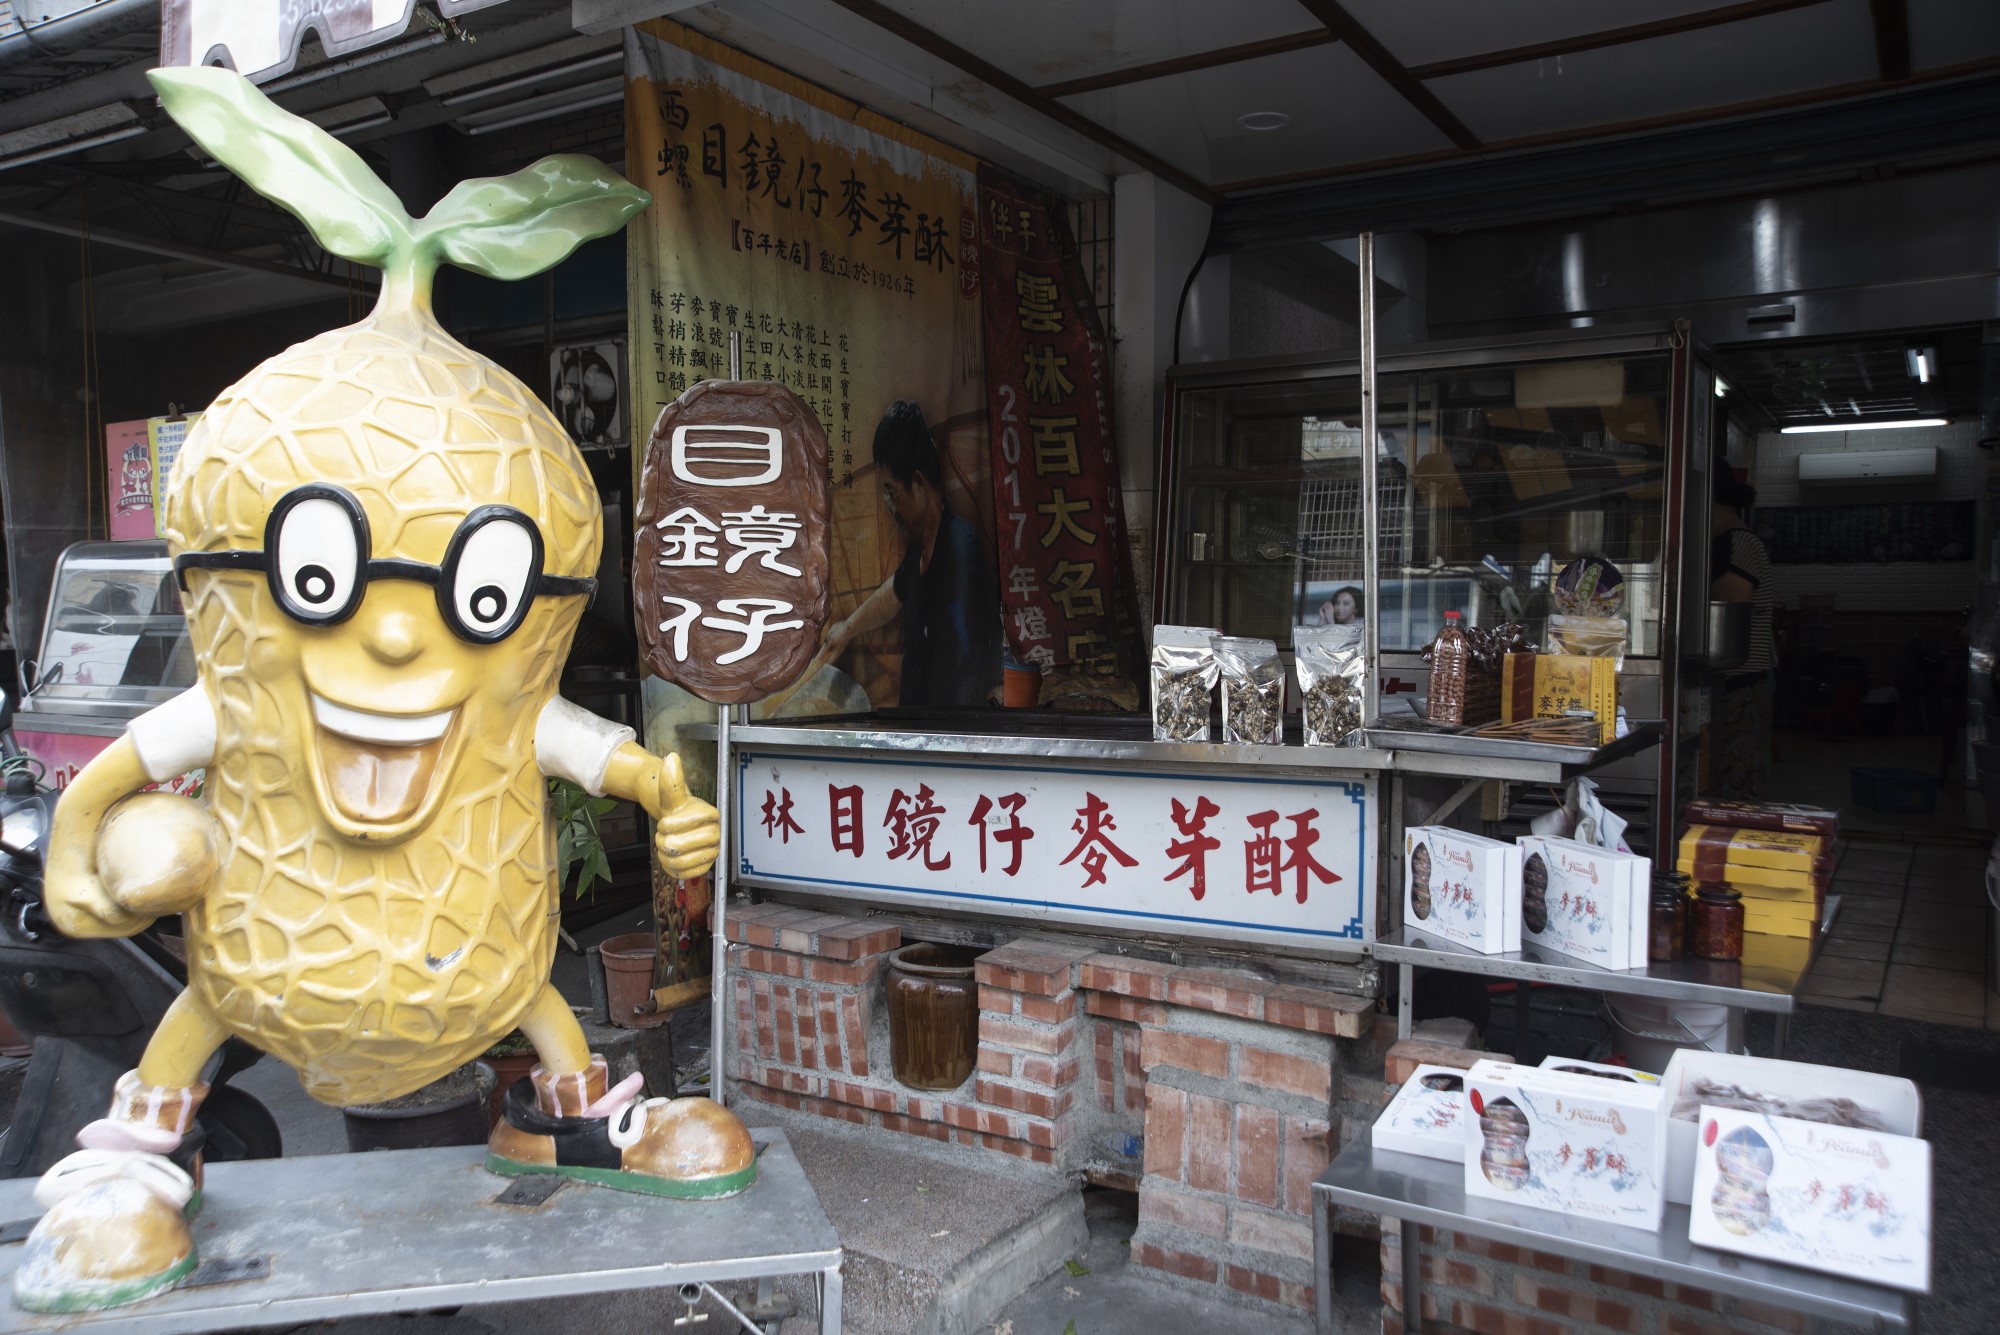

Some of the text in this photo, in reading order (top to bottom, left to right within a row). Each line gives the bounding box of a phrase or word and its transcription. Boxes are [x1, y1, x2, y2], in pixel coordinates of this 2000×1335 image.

[658, 89, 691, 189] 西螺
[702, 122, 955, 274] 目鏡仔麥芽酥
[819, 250, 916, 300] 創立於1926年
[961, 217, 982, 291] 目鏡仔
[744, 310, 757, 379] 生生不
[777, 318, 790, 384] 大人小
[791, 321, 806, 401] 清茶淡
[838, 333, 854, 490] 花生寶寶打油詩
[656, 424, 804, 665] 目鏡仔
[760, 782, 1343, 905] 林目鏡仔麥芽酥
